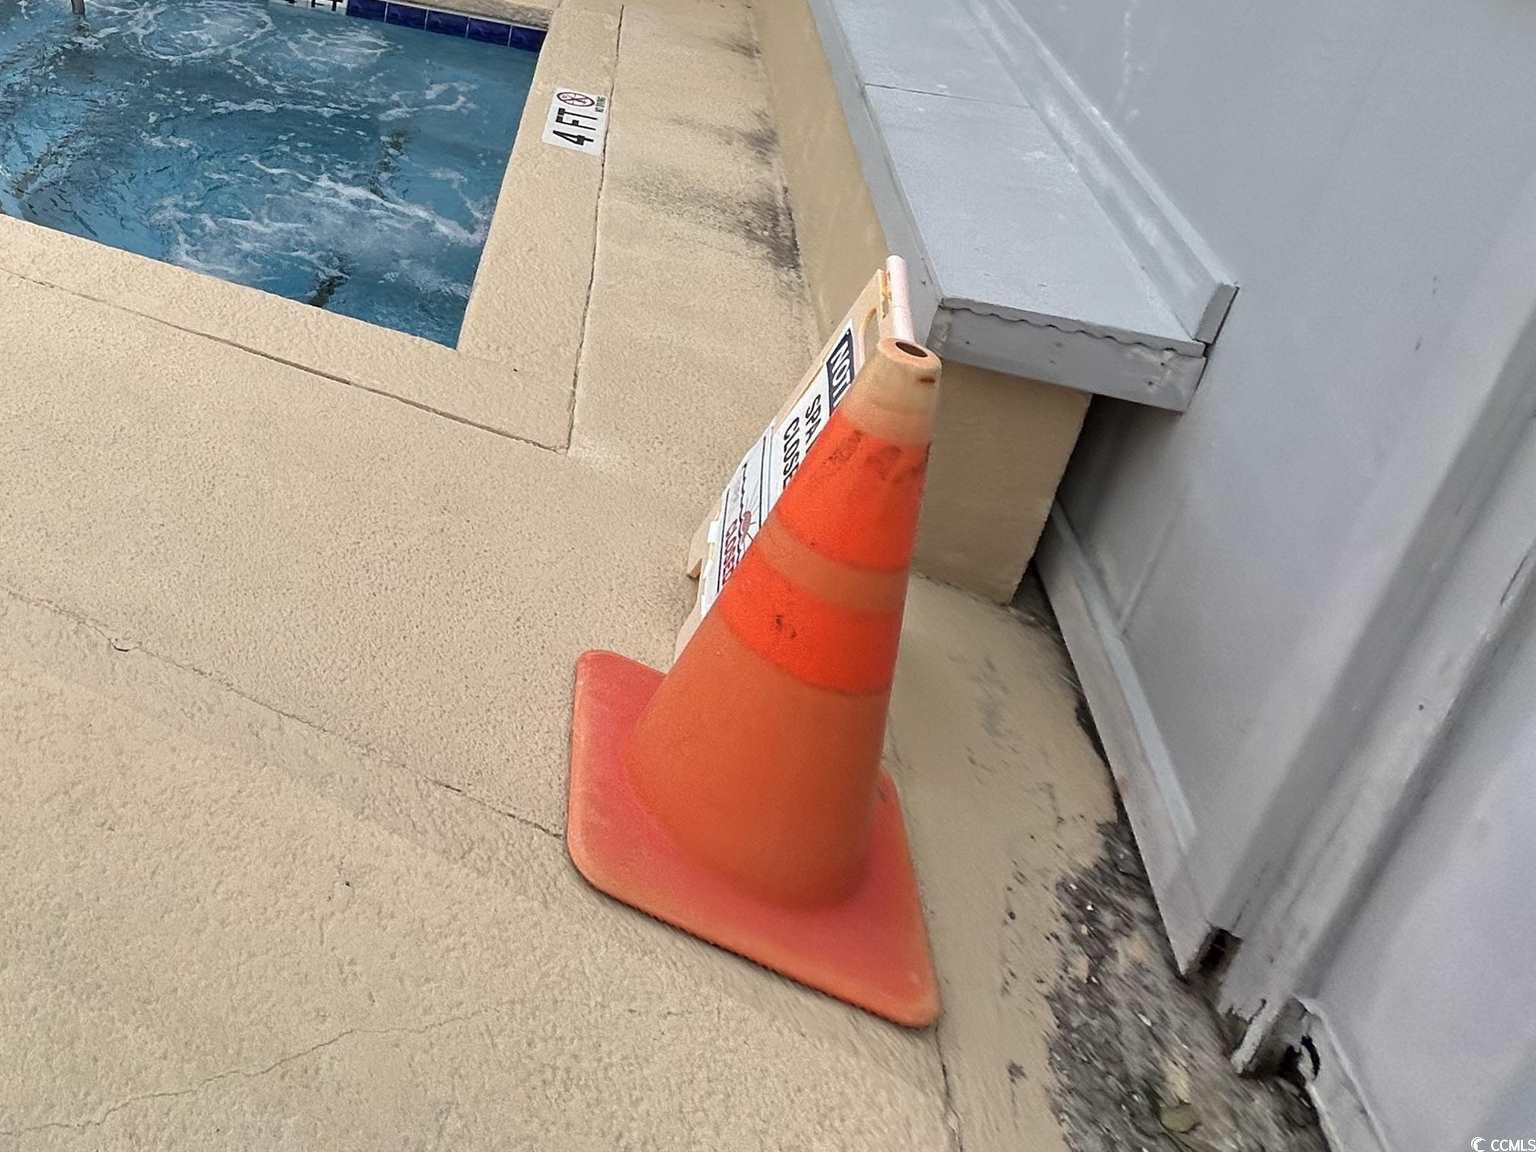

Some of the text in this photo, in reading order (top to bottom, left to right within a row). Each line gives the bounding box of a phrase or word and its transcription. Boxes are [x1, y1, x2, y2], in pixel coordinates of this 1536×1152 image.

[552, 107, 598, 146] 4 FT
[805, 393, 822, 445] SPA
[783, 416, 800, 490] CLOSE
